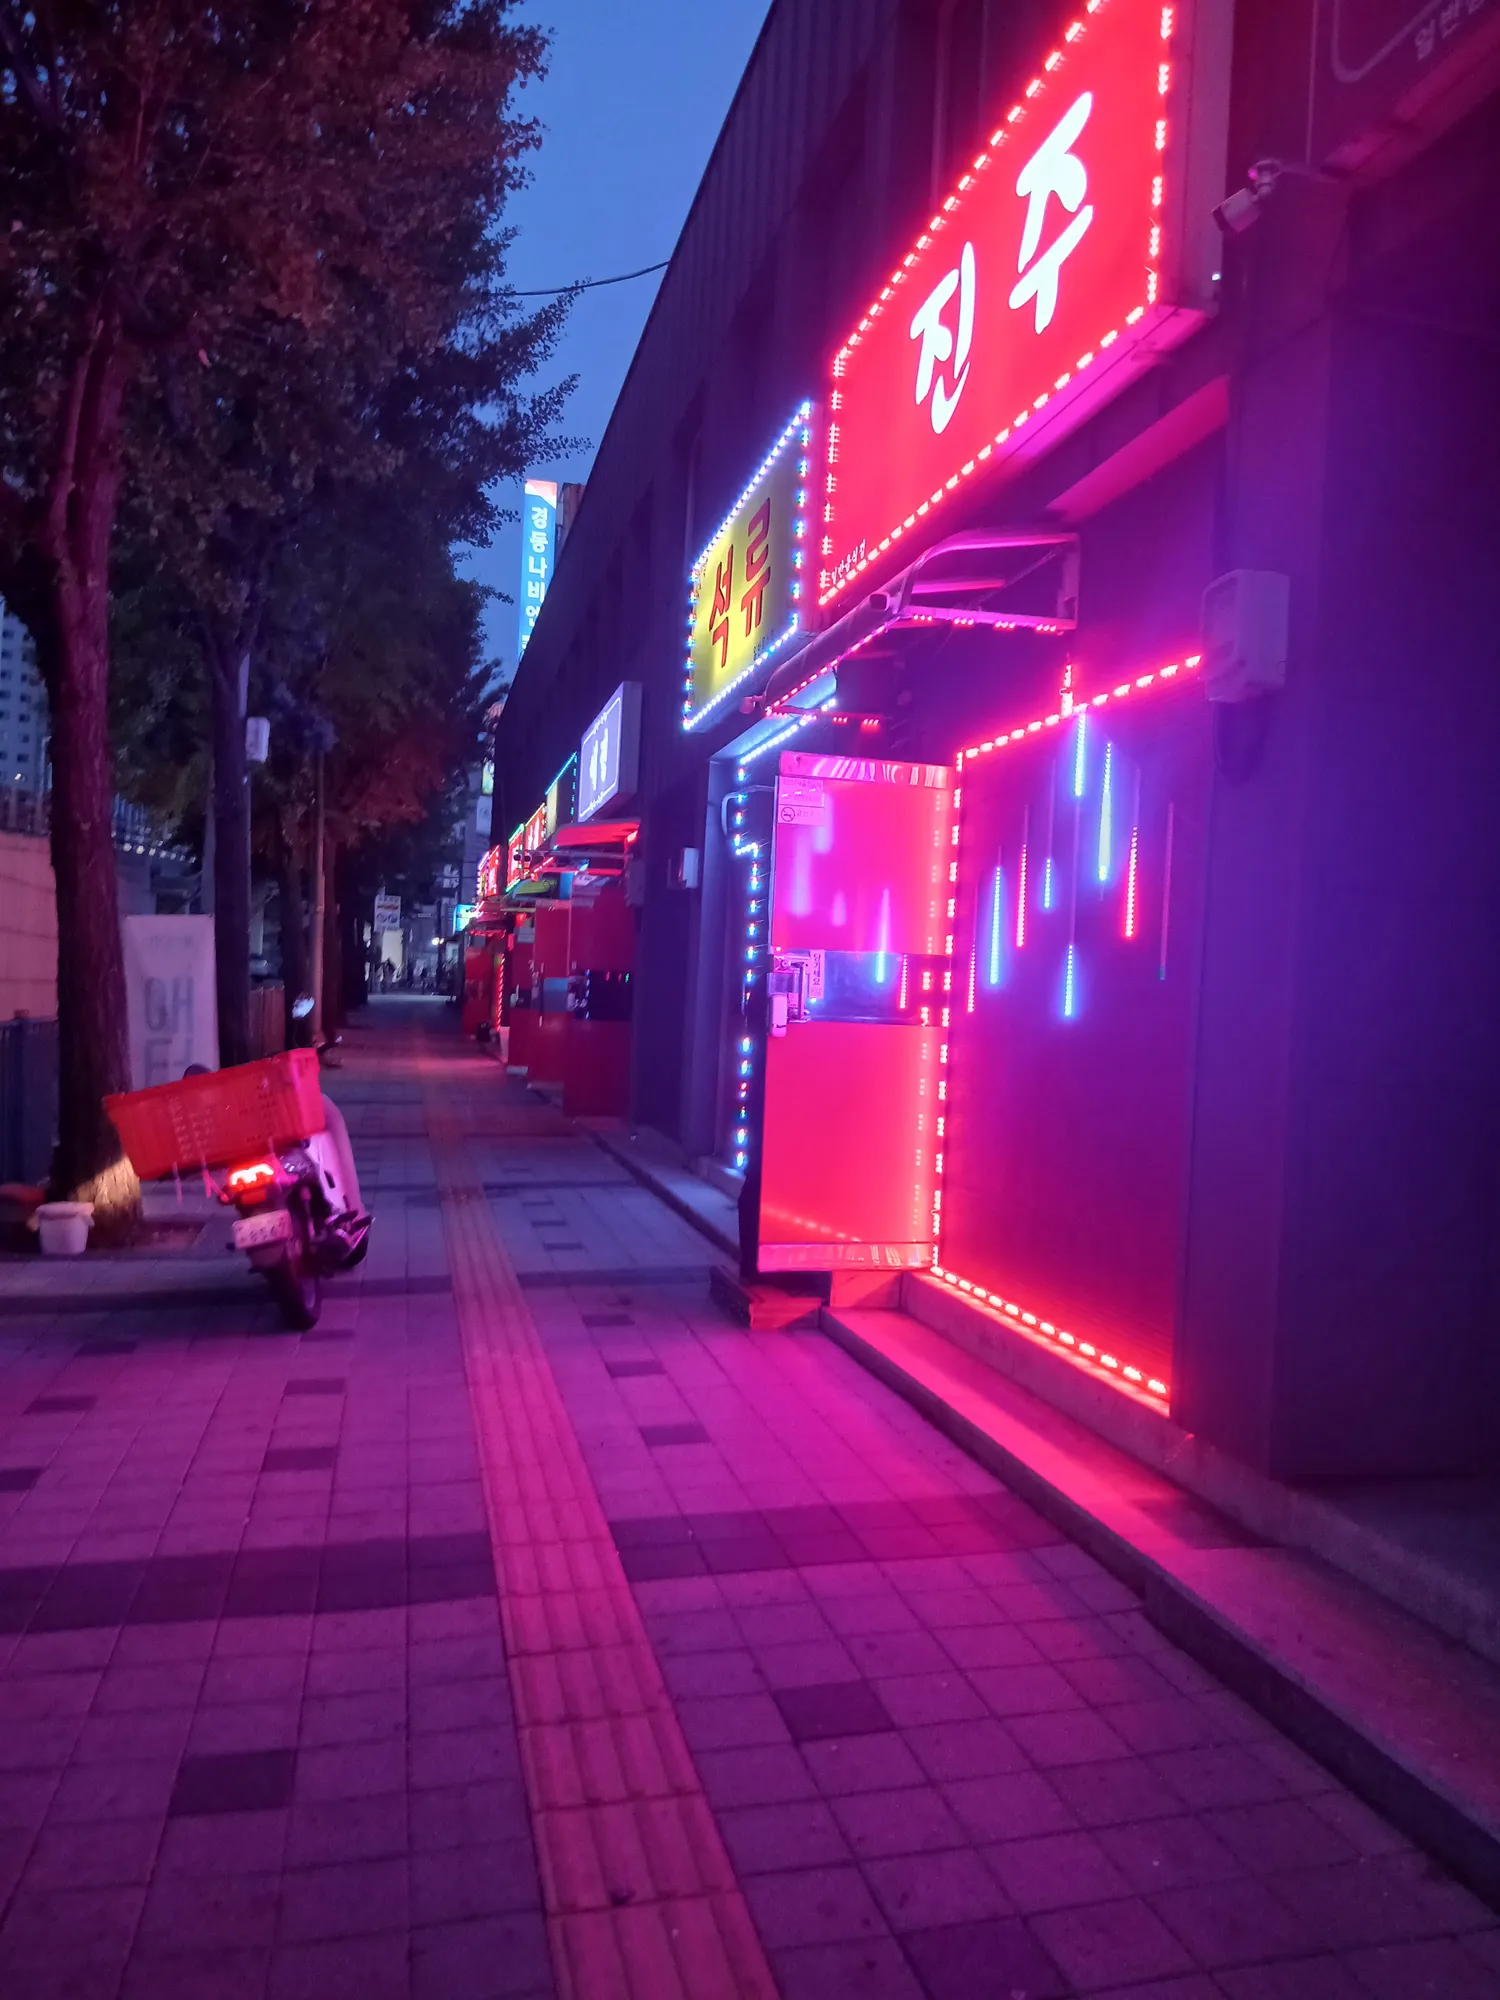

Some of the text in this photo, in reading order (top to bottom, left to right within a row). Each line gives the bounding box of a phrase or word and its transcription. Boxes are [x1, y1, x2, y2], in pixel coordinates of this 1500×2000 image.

[910, 90, 1094, 434] 진주
[708, 496, 772, 669] 석류
[812, 953, 822, 986] 당기세요
